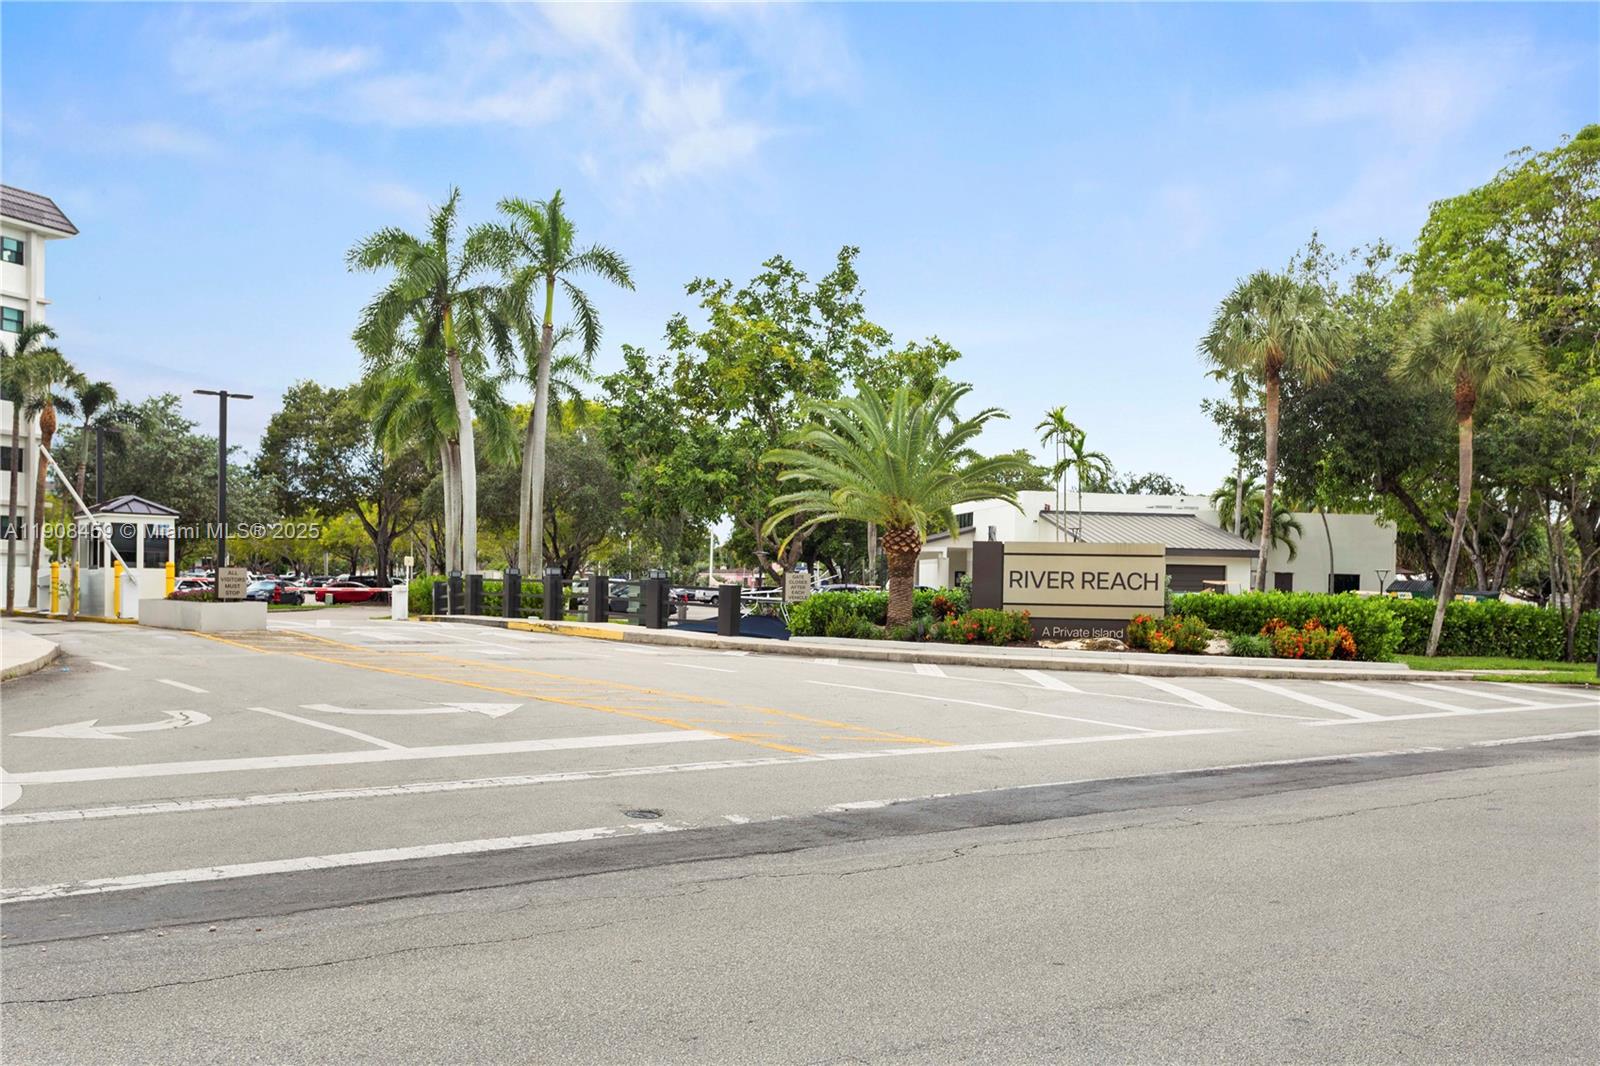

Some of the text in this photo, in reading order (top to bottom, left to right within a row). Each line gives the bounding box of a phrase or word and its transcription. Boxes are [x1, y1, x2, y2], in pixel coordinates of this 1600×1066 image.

[1009, 570, 1159, 591] RIVER REACH
[1041, 626, 1124, 639] A Private Island
